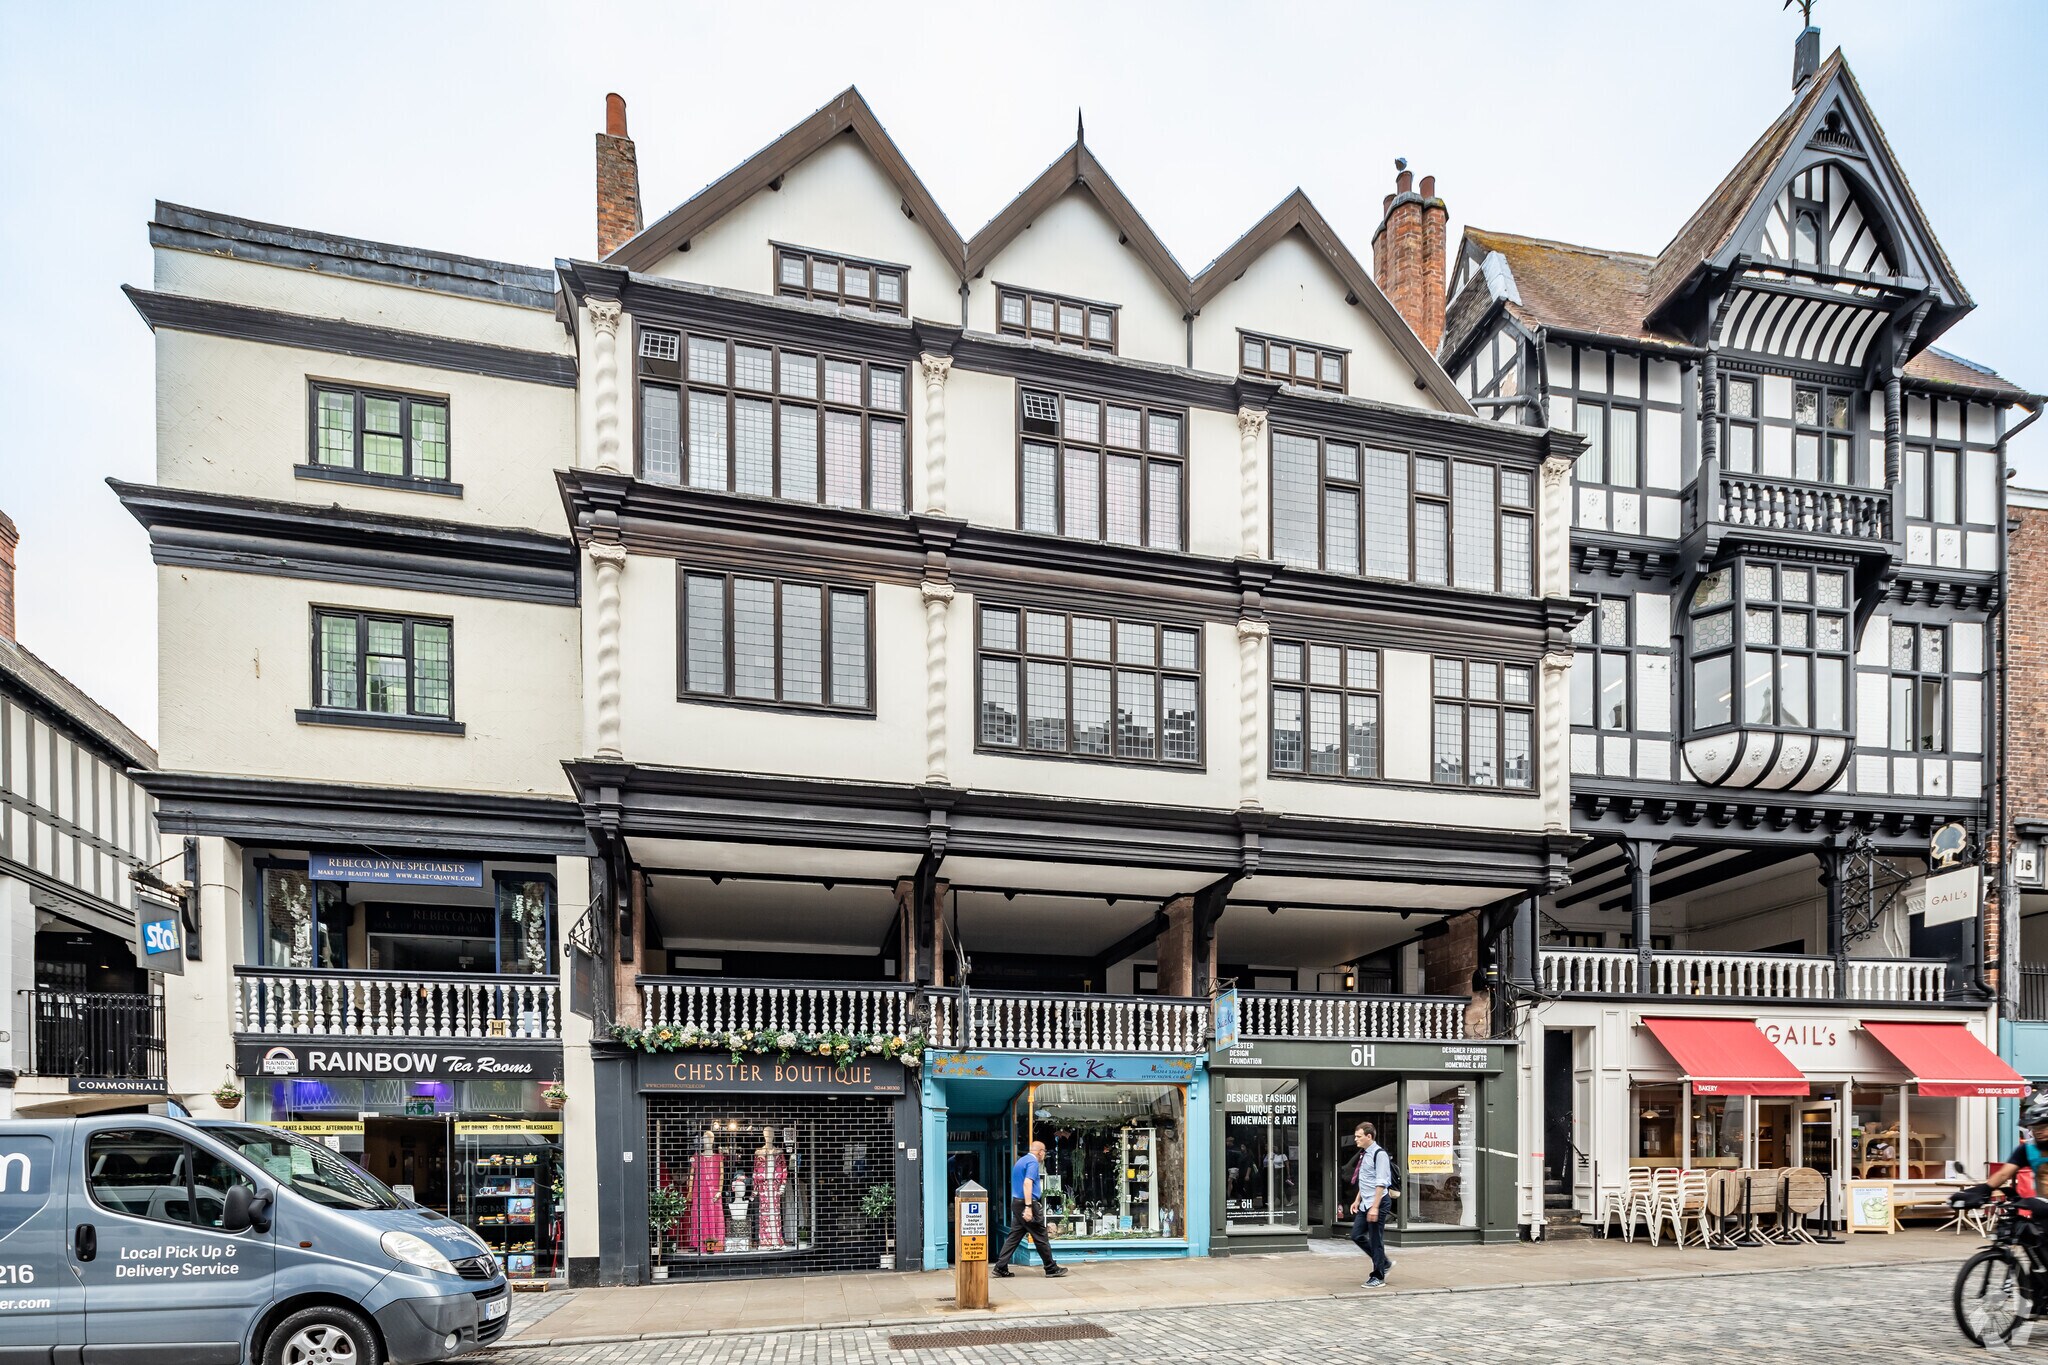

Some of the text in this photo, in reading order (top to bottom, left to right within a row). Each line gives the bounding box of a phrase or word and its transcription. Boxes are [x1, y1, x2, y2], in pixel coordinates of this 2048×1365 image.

[328, 858, 372, 868] REBECCA
[374, 860, 406, 870] JAYNE
[2020, 860, 2032, 871] 18
[1932, 890, 1968, 906] GAIL's
[1765, 1024, 1836, 1046] GAIL's
[309, 1052, 533, 1073] RAINBOW Tea Rooms
[1017, 1057, 1079, 1078] Suzie
[674, 1063, 872, 1085] CHESTER BOUTIQUE
[78, 1081, 165, 1090] COMMONHALL
[1226, 1093, 1297, 1103] DESIGNER FASHION
[1245, 1105, 1296, 1115] UNIQUE GIFTS
[1231, 1116, 1297, 1124] HOMEWARE & ART
[971, 1205, 978, 1213] P
[120, 1244, 237, 1260] Local Pick Up &
[116, 1263, 239, 1278] Delivery Service
